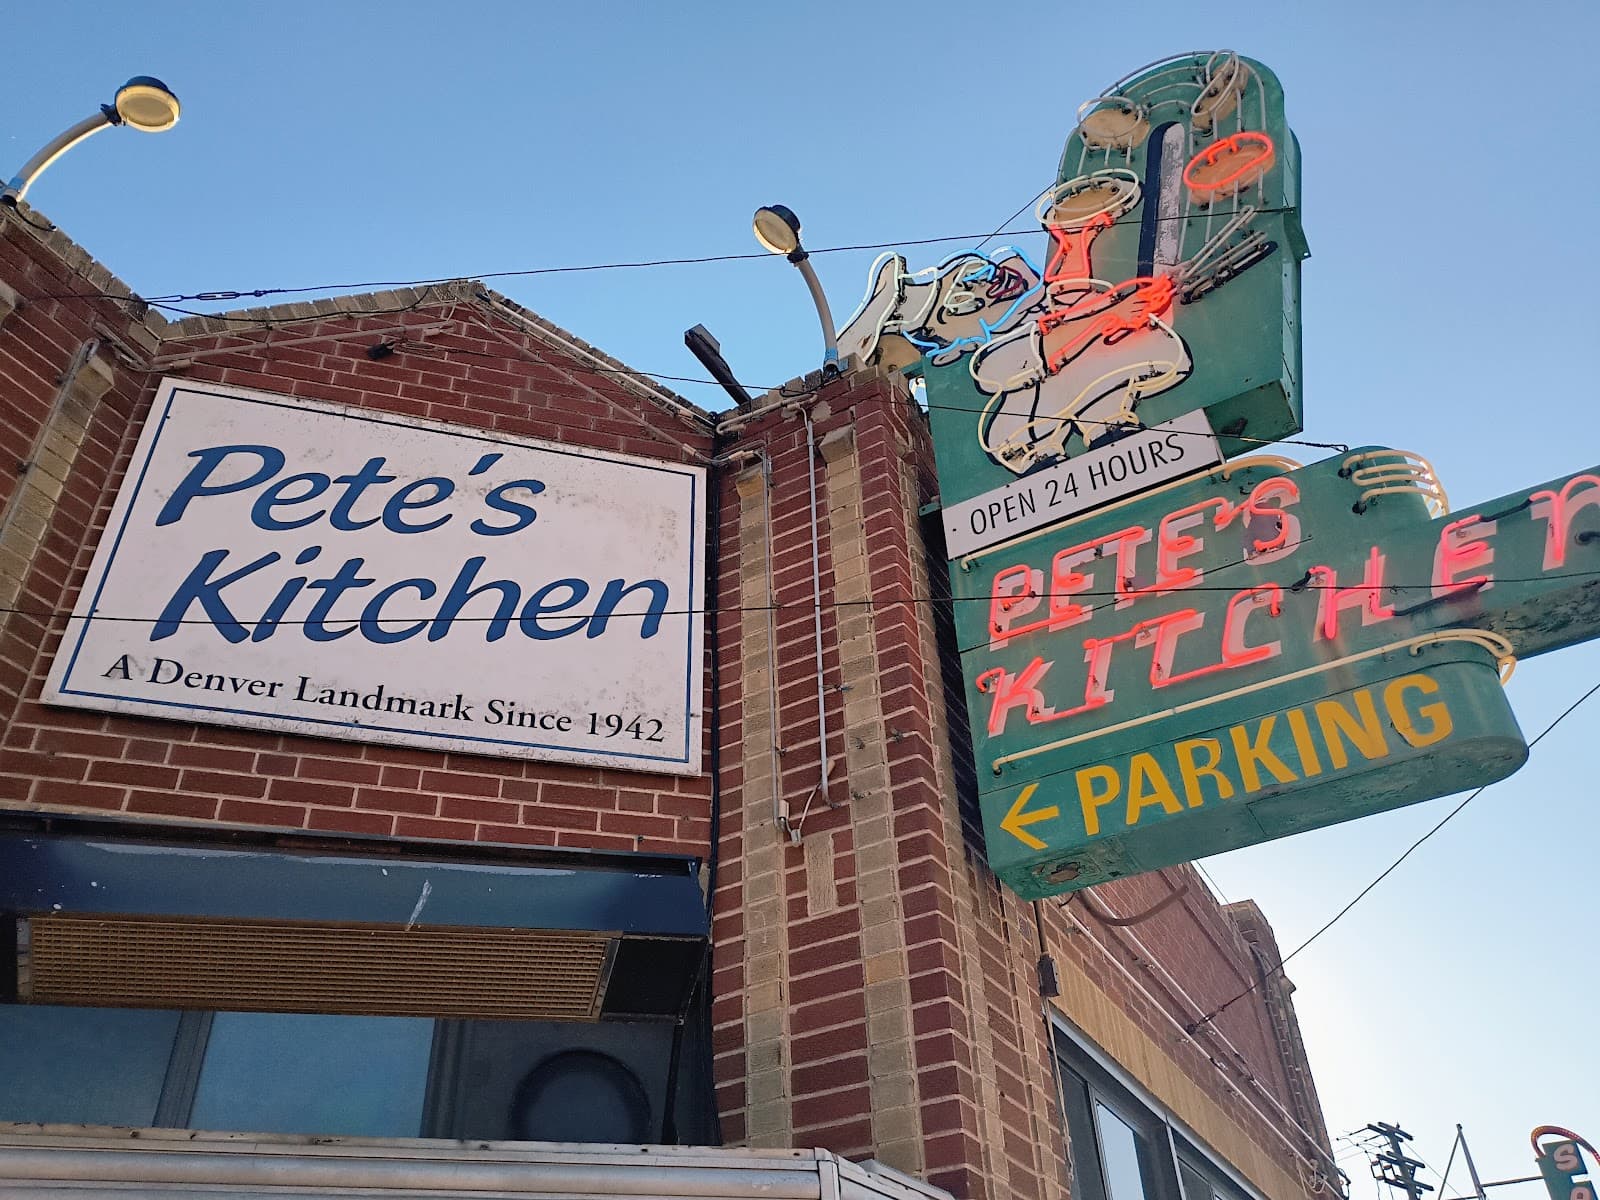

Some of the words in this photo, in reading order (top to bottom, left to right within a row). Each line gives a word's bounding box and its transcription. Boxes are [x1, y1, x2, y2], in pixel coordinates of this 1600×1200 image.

[155, 444, 546, 536] Pete's
[970, 489, 1036, 536] OPEN
[1045, 472, 1079, 507] 24
[1087, 434, 1185, 490] HOURS
[149, 546, 669, 643] Kitchen
[988, 477, 1302, 651] PETE'S
[101, 654, 132, 680] A
[147, 658, 284, 700] Denver
[294, 677, 473, 722] Landmark
[485, 699, 573, 732] Since
[587, 712, 665, 743] 1942
[1075, 675, 1453, 837] PARKING
